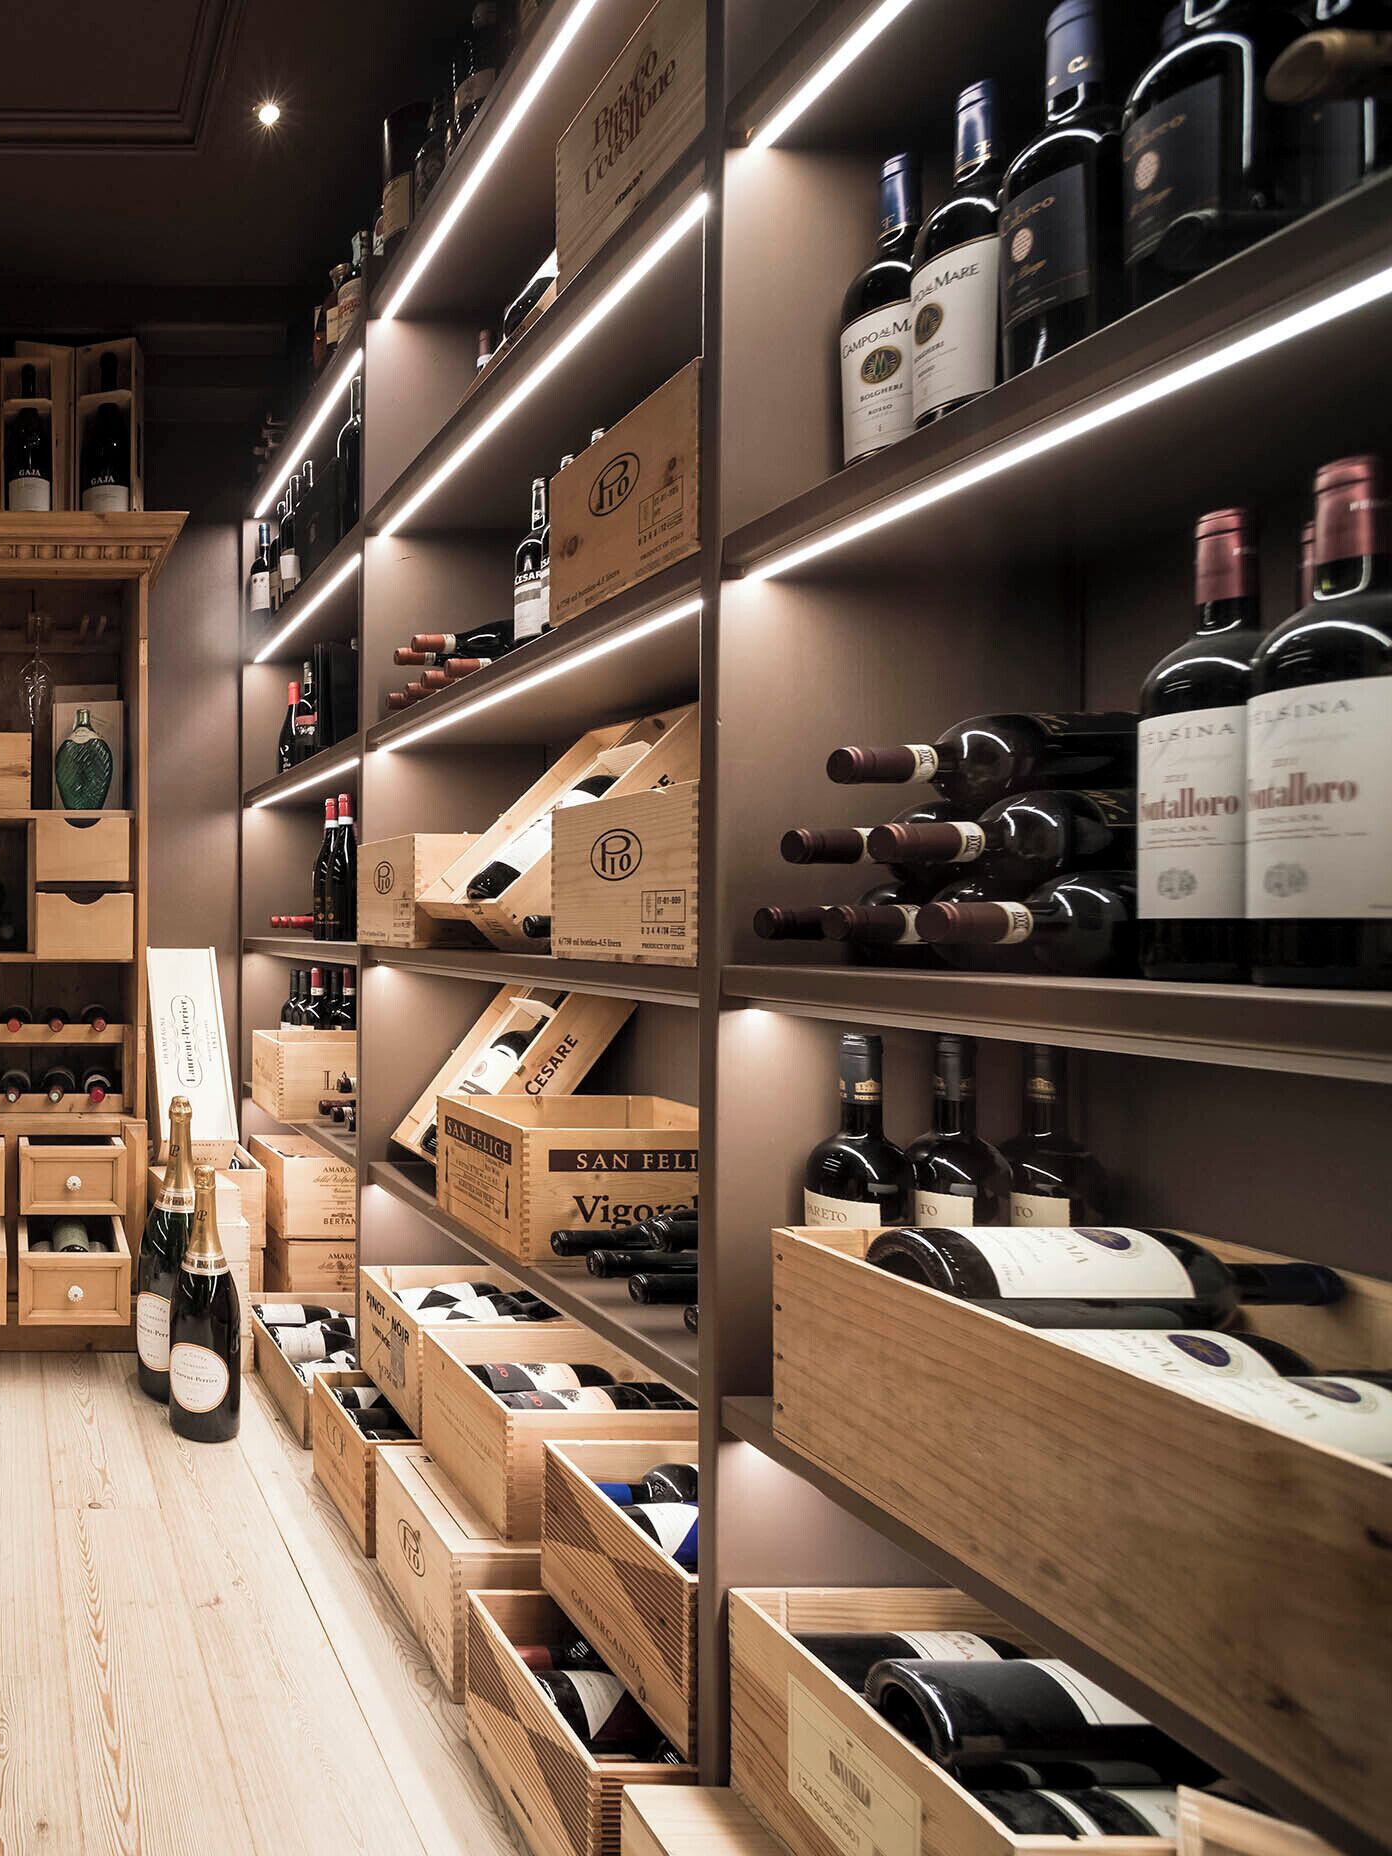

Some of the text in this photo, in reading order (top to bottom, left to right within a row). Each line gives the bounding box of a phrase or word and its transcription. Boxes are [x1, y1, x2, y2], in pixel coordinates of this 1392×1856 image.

[935, 263, 980, 290] MARE
[841, 330, 879, 361] CAMPO
[860, 383, 904, 403] BOLGHERI
[868, 404, 894, 416] ROSSO
[18, 468, 42, 478] GAJA
[90, 476, 115, 486] GAJA
[515, 570, 541, 587] CESAR
[641, 942, 664, 950] PRODUCT
[178, 999, 196, 1082] Laurent-Perrier
[524, 1033, 579, 1098] CESARE
[445, 1119, 510, 1162] SAN FELICE
[576, 1152, 699, 1170] SAN FELI
[365, 1290, 386, 1321] PINOT
